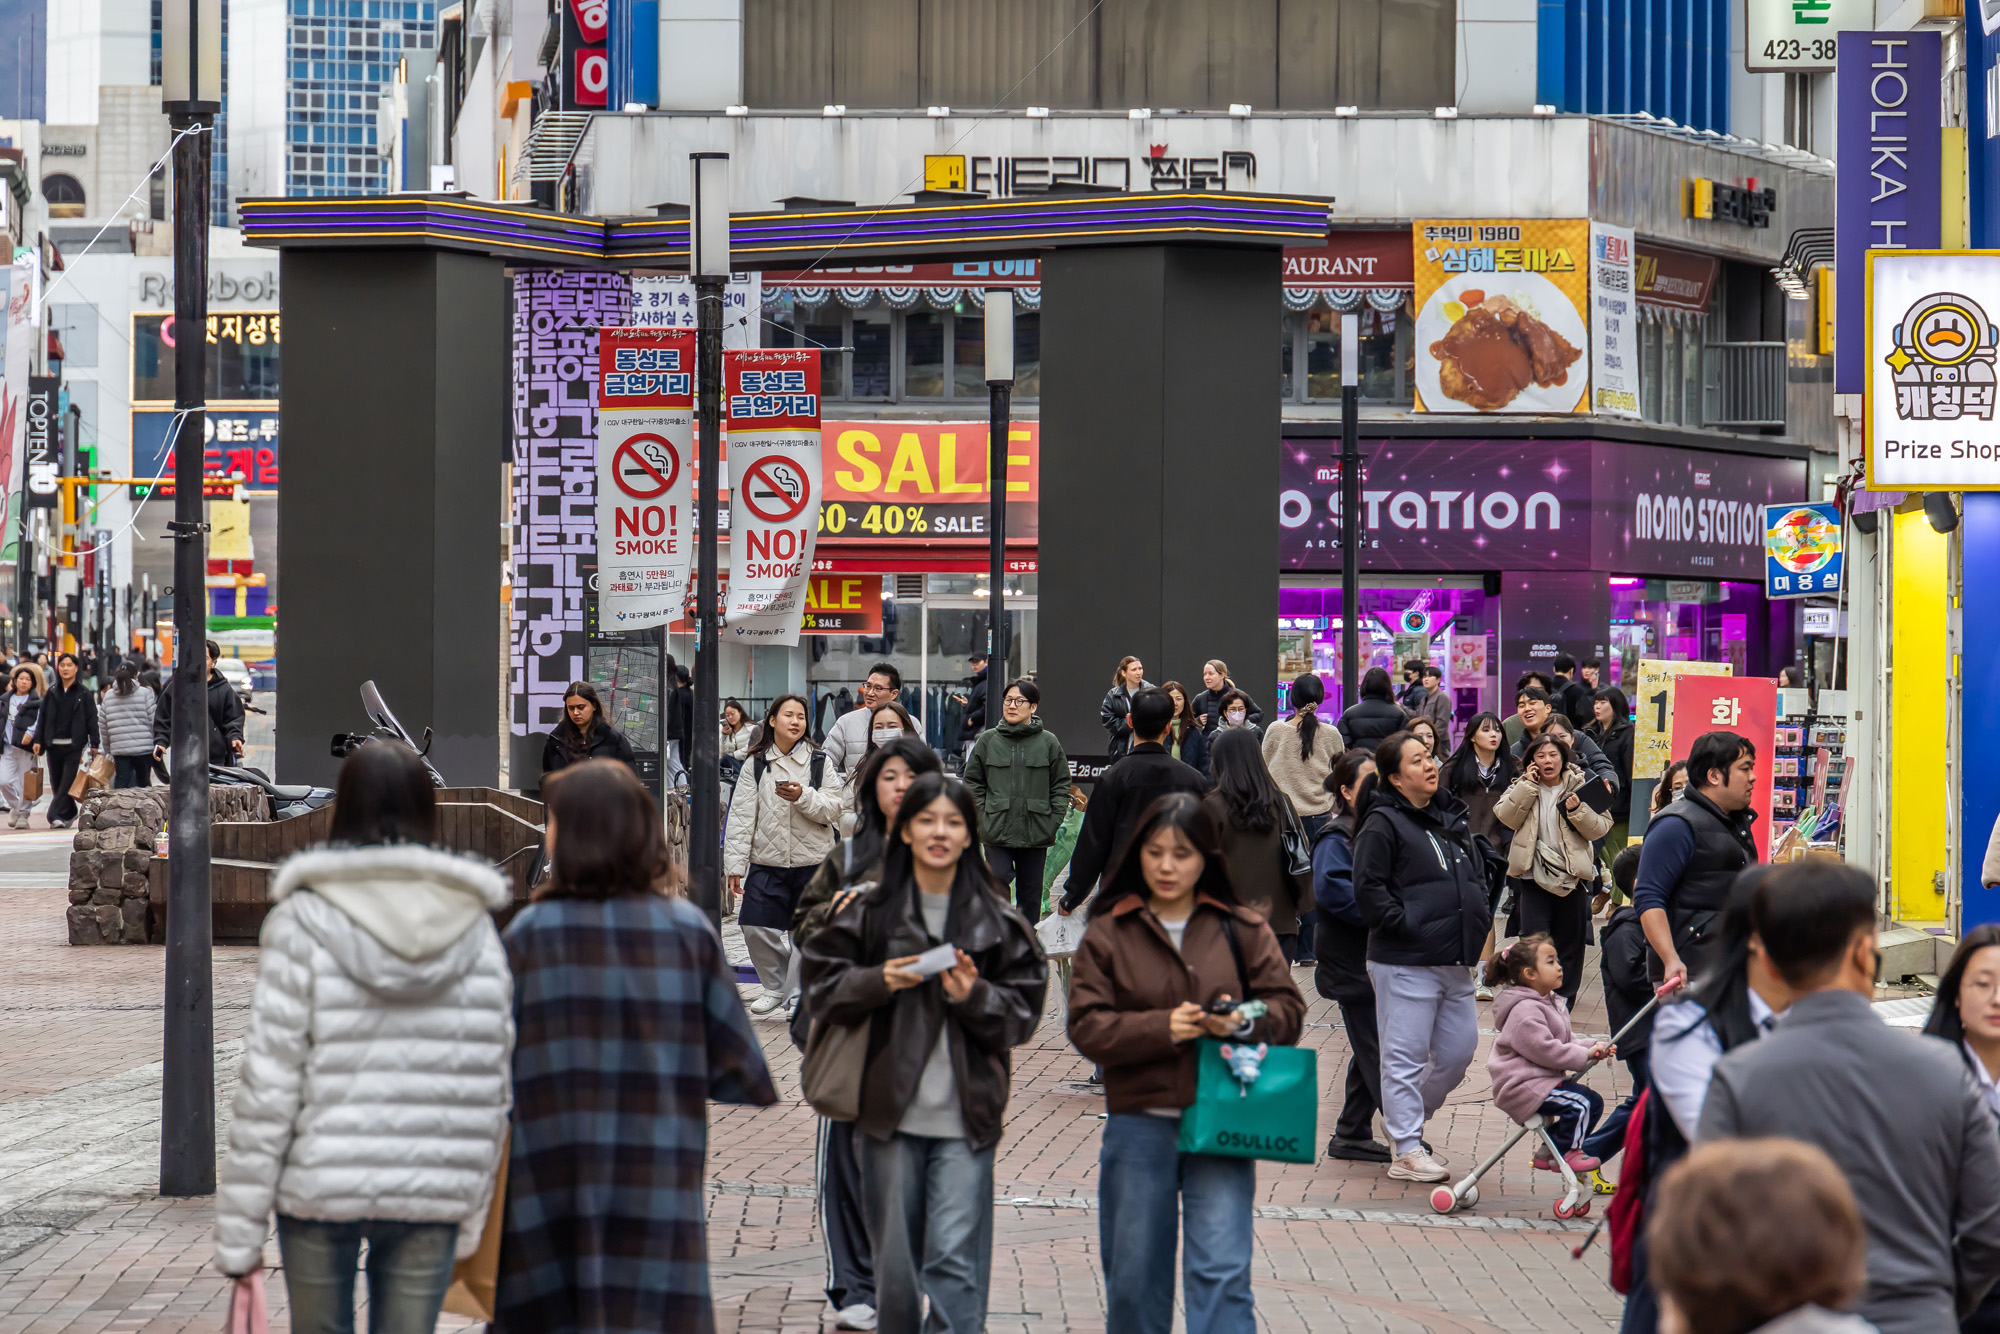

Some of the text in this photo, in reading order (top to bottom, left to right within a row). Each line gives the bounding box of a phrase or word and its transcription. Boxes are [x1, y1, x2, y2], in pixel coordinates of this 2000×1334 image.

[1871, 40, 1908, 203] HOLIKA
[1424, 225, 1521, 242] 추억의 1980
[1441, 247, 1576, 273] 심해돈까스
[615, 348, 681, 371] 동성로
[604, 373, 690, 396] 금연거리
[740, 371, 806, 393] 동성로
[730, 394, 816, 418] 금연거리
[1895, 384, 1995, 421] 캐칭덕
[1885, 440, 1942, 459] Prize
[834, 430, 1031, 494] SALE
[615, 505, 678, 538] NO!
[934, 516, 984, 533] SALE
[1635, 493, 1695, 542] MOMO
[615, 539, 678, 556] SMOKE
[746, 529, 808, 561] NO!
[619, 569, 675, 581] 흡연시 5만원의
[745, 562, 803, 579] SMOKE
[609, 580, 682, 592] 과태료가 부과됩니다
[747, 593, 772, 602] 흡연시
[629, 610, 661, 619] 대구광역시
[818, 618, 841, 628] SALE
[1711, 696, 1742, 727] 화
[1648, 739, 1670, 750] 24K
[1216, 1130, 1299, 1153] OSULLOC
